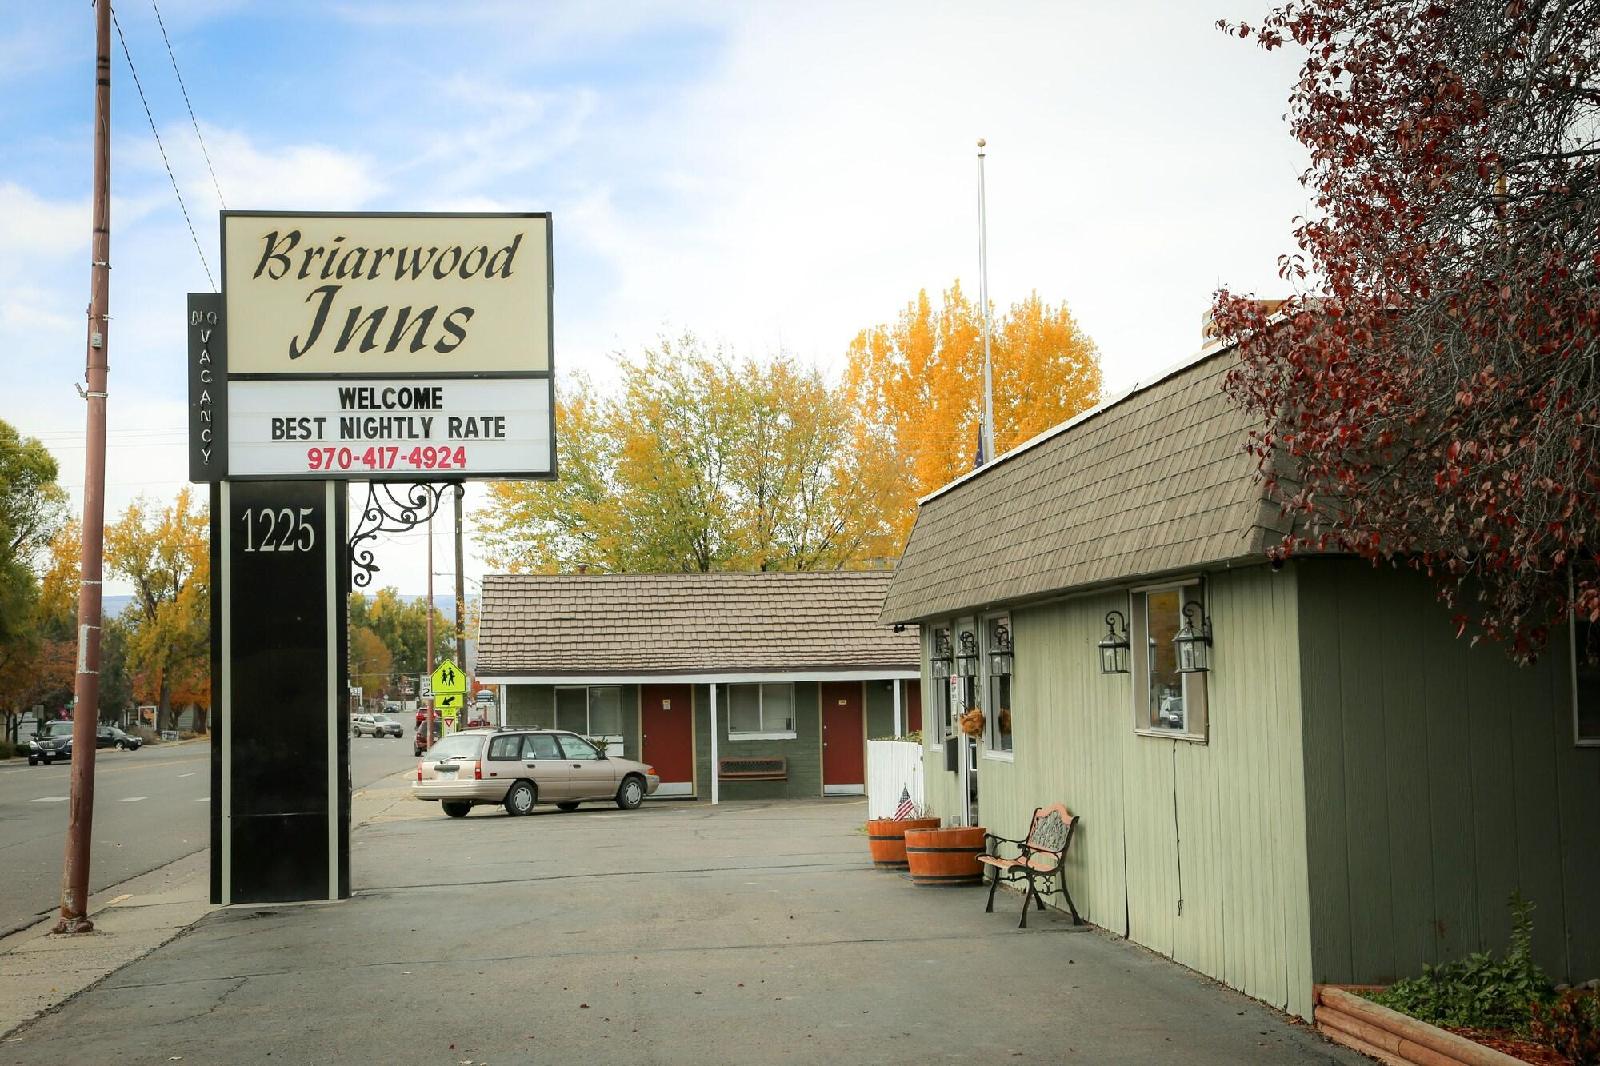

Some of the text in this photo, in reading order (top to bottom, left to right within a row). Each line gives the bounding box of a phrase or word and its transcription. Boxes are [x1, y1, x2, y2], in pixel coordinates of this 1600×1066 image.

[253, 229, 523, 281] Briarwood
[191, 310, 217, 326] NO
[288, 284, 475, 360] Inns
[199, 329, 212, 465] VACANCY
[338, 387, 443, 410] WELCOME
[271, 416, 506, 440] BEST NIGHTLY RATE
[307, 446, 467, 470] 970-417-4924
[242, 508, 315, 552] 1225
